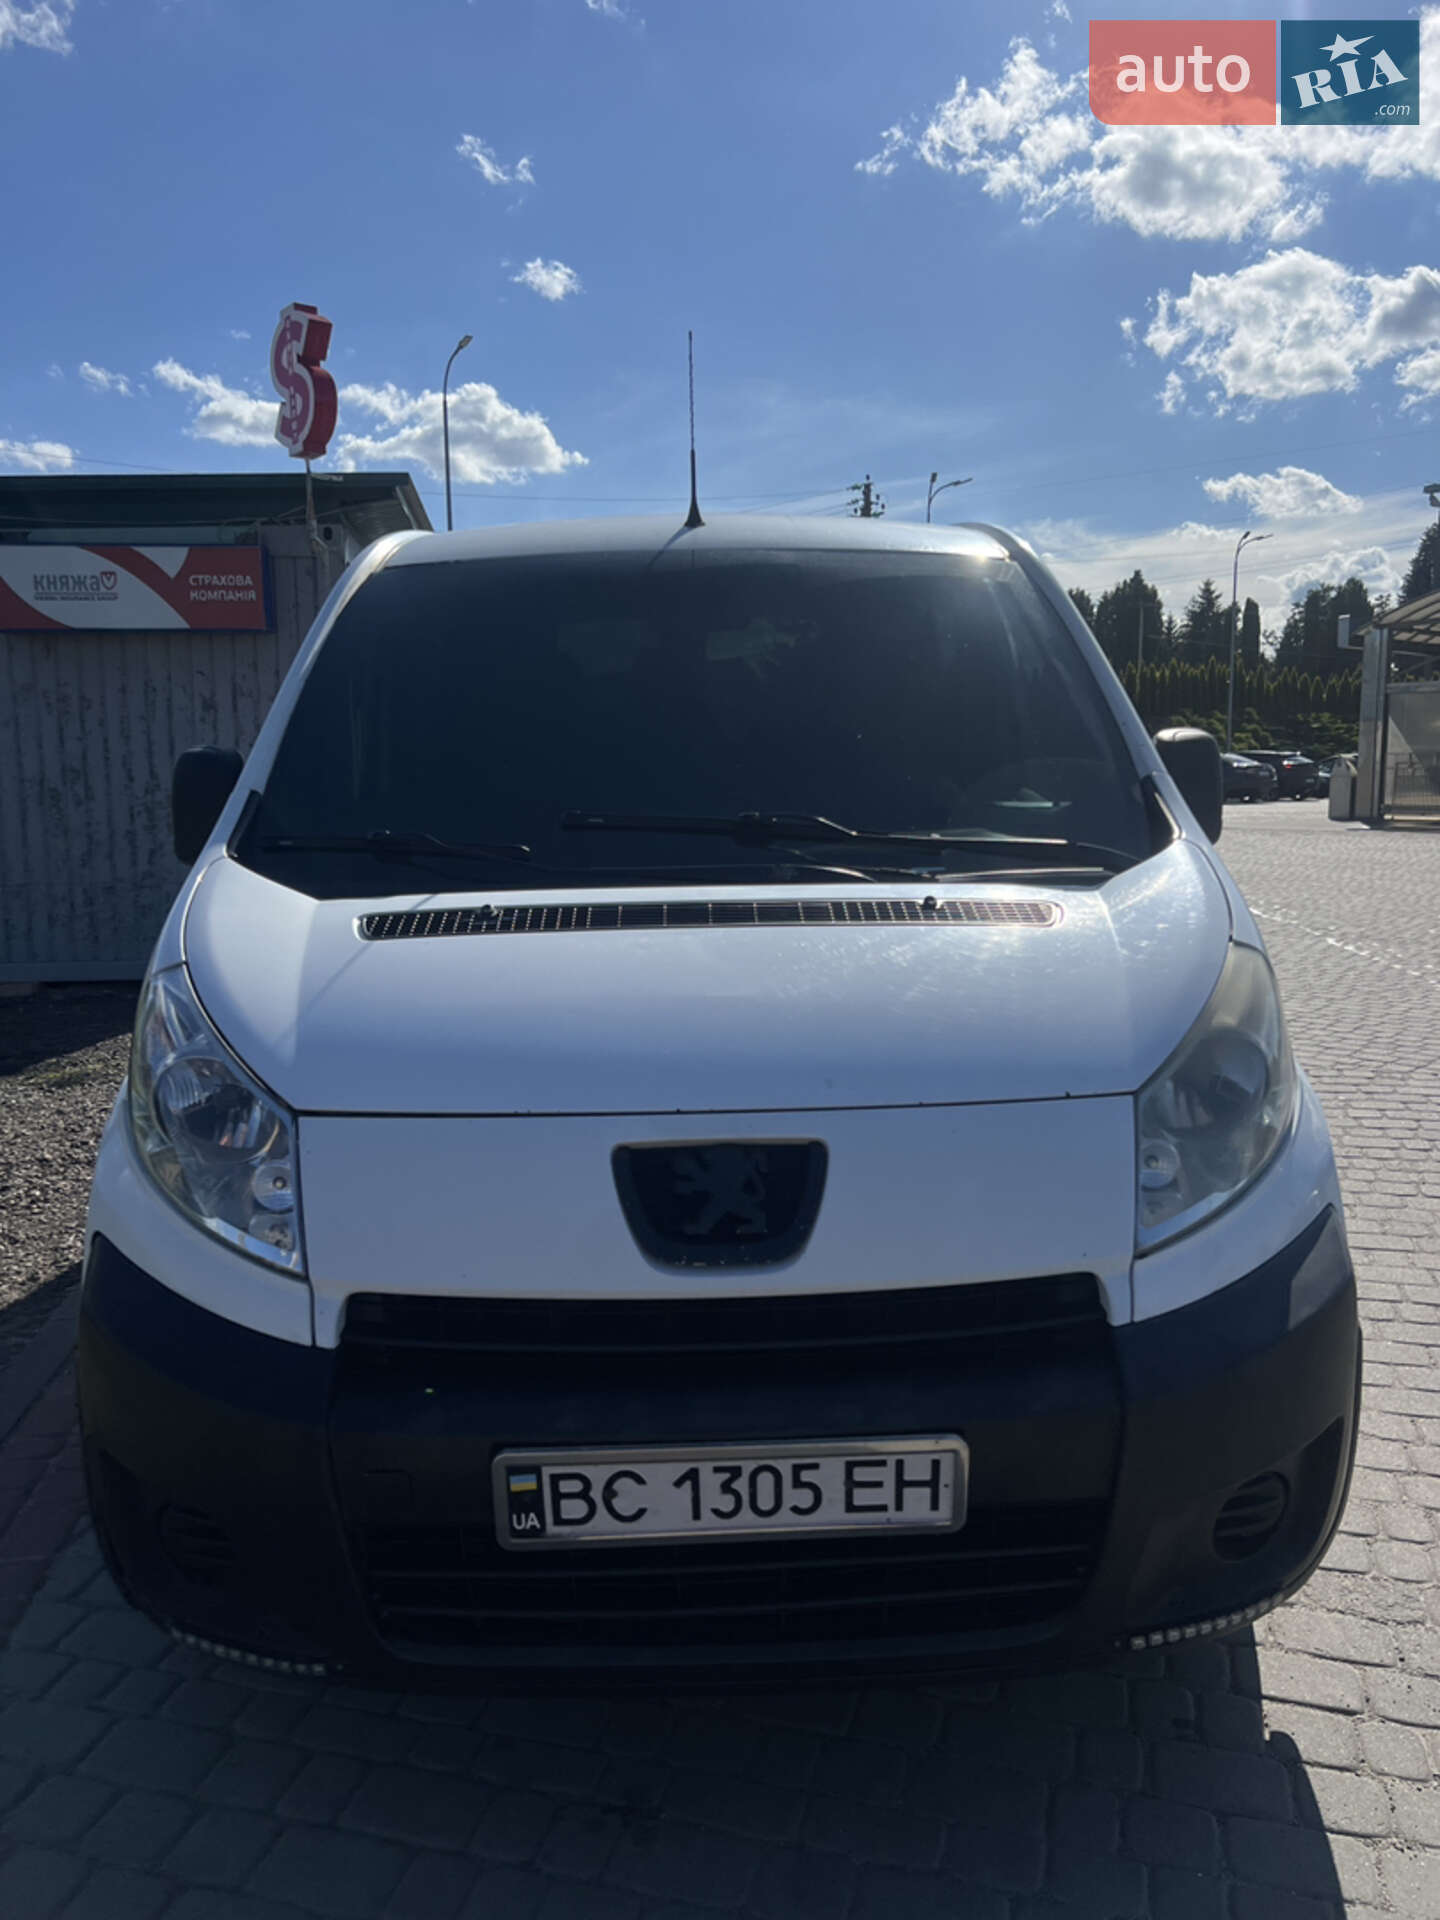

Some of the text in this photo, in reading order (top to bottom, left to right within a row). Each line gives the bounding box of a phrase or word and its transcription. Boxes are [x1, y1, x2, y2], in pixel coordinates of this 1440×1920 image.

[189, 574, 253, 586] СТРАХОВА
[190, 590, 257, 601] КОМПАНІЯ
[672, 1462, 823, 1521] 1305
[844, 1458, 941, 1514] EH
[512, 1512, 540, 1530] UA
